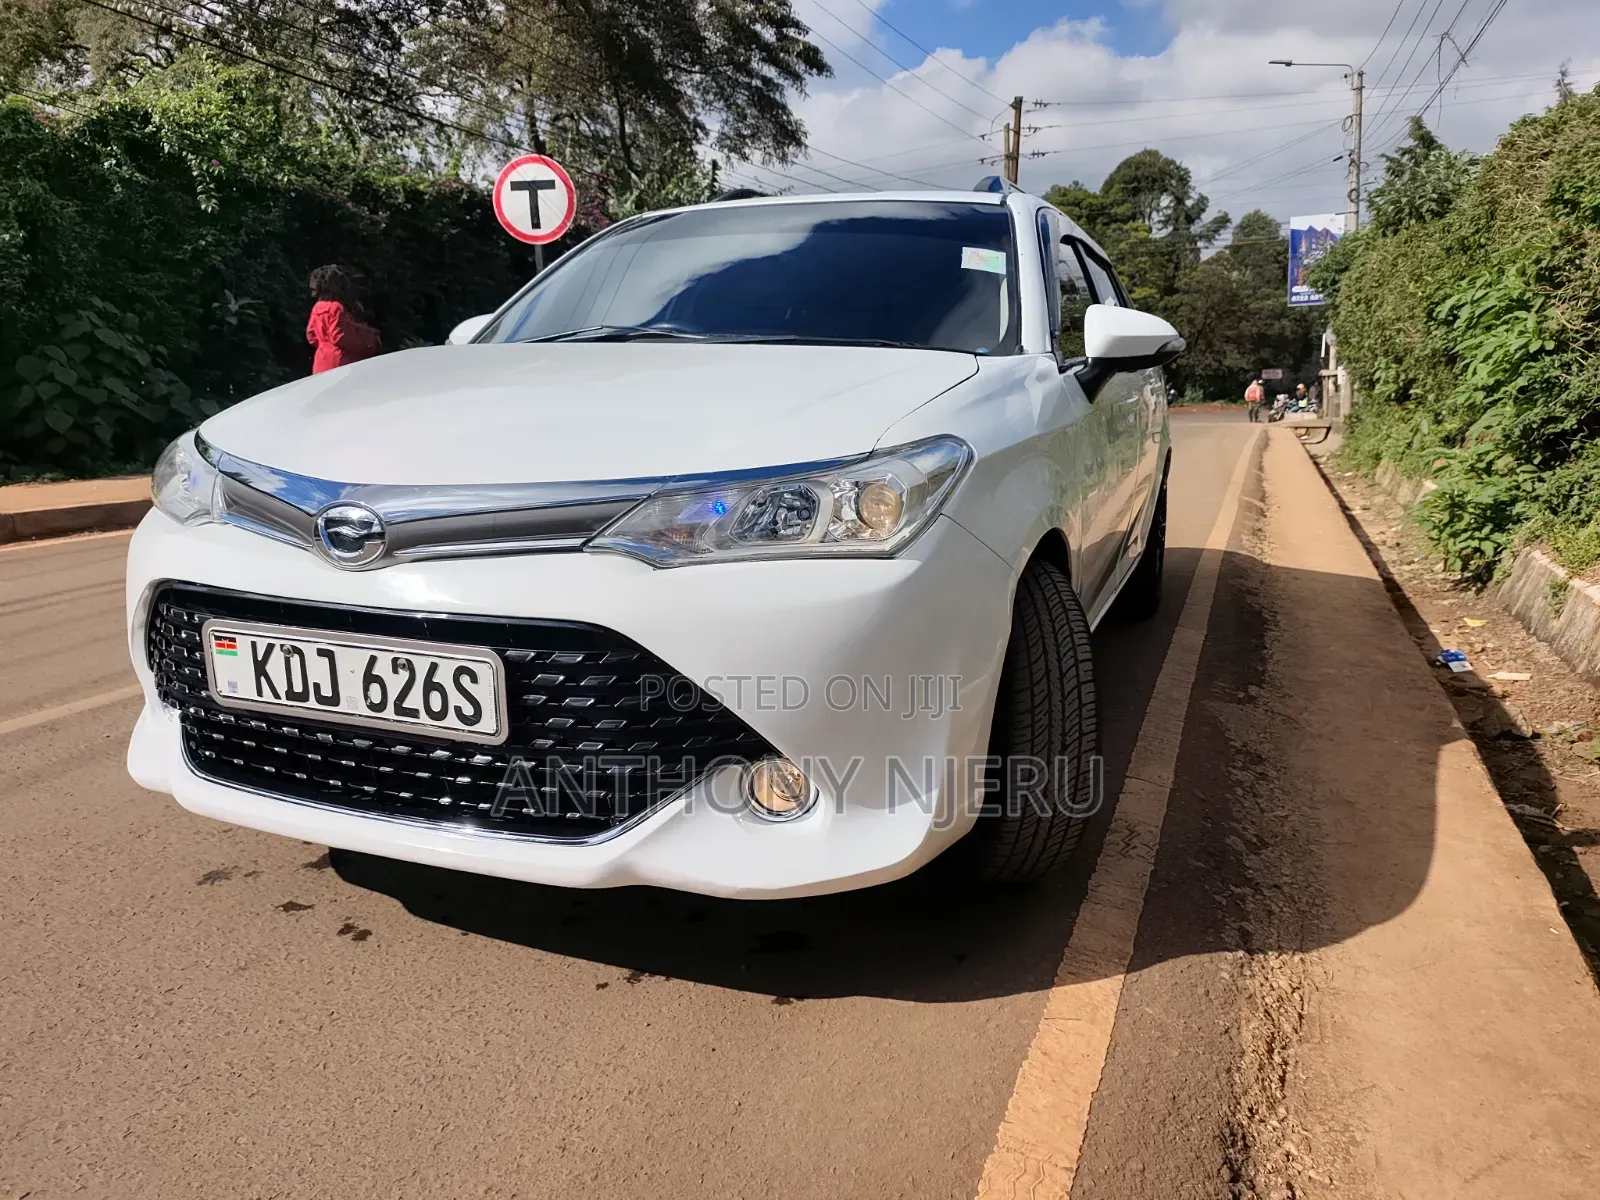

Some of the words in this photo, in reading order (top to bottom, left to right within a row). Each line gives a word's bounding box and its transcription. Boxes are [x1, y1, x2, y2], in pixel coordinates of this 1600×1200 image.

[509, 179, 556, 230] T
[250, 640, 341, 708] KDJ
[362, 654, 483, 726] 626S
